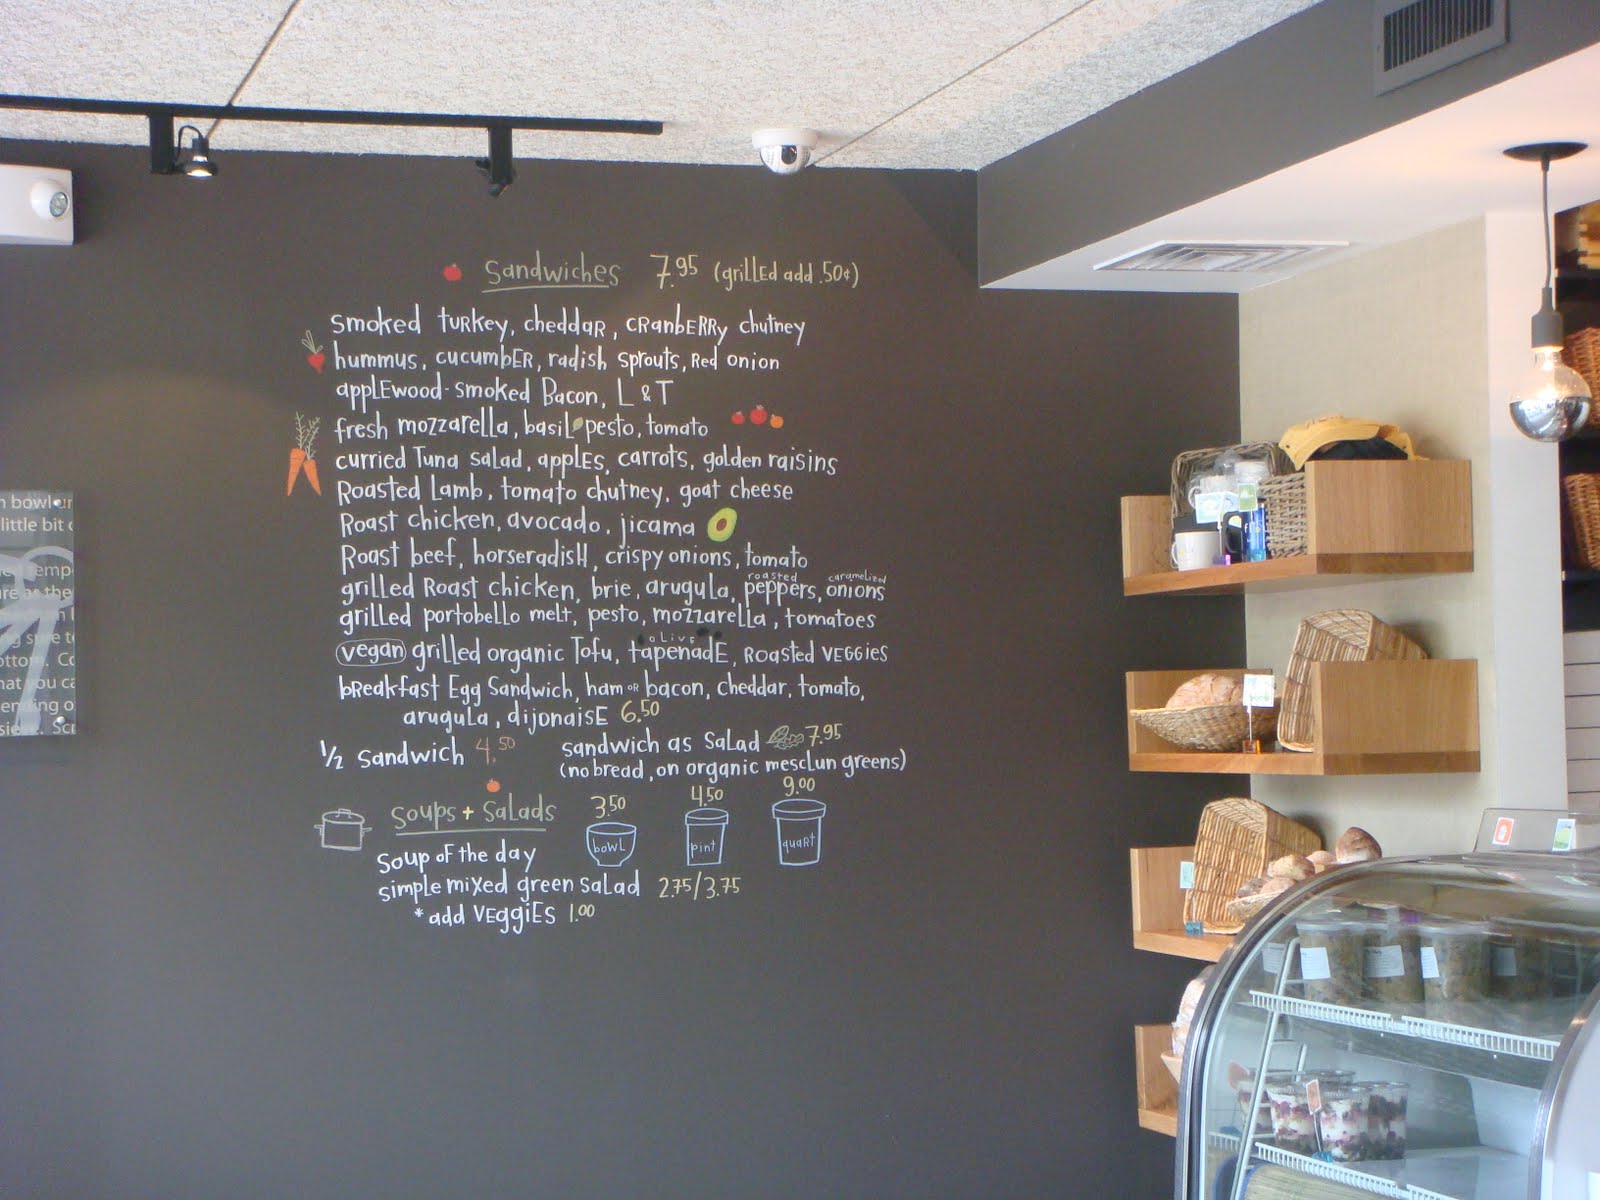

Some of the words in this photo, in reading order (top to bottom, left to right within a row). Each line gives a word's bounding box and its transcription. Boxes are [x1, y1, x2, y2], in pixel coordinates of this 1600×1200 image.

[485, 250, 620, 287] Sandwiches
[650, 254, 698, 289] 7.95
[783, 262, 813, 284] add
[739, 309, 806, 346] chutney
[333, 340, 426, 371] hummus,
[548, 344, 607, 371] radish
[618, 347, 686, 377] sprouts,
[691, 346, 717, 370] Red
[727, 352, 780, 371] onion
[542, 377, 606, 409] Bacon,
[617, 378, 634, 406] L
[641, 385, 651, 402] &
[655, 380, 674, 405] T
[334, 411, 388, 443] fresh
[648, 413, 709, 437] tomato
[335, 443, 406, 470] curried
[413, 446, 459, 469] Tuna
[618, 444, 694, 470] carrots,
[768, 447, 838, 475] raisins
[12, 494, 51, 510] bowl
[337, 475, 421, 506] Roasted
[431, 472, 493, 501] Lamb,
[500, 476, 577, 505] tomato
[586, 475, 670, 508] chutney,
[679, 479, 721, 507] goat
[730, 476, 793, 500] cheese
[1, 516, 38, 532] little
[42, 516, 65, 532] bit
[340, 510, 399, 537] Roast
[407, 505, 501, 531] chicken,
[507, 505, 611, 535] avocado,
[619, 512, 695, 549] jicama
[341, 541, 400, 575] Roast
[410, 537, 463, 569] beef,
[605, 547, 663, 571] crispy
[668, 545, 740, 569] onions,
[744, 542, 808, 568] tomato
[424, 576, 478, 599] Roast
[488, 571, 581, 603] chicken,
[591, 575, 640, 600] brie,
[744, 580, 822, 607] peppers,
[826, 583, 886, 601] onions
[748, 572, 798, 582] roasted
[588, 604, 647, 632] pesto,
[785, 608, 876, 629] tomatoes
[341, 642, 404, 664] vegan
[487, 643, 564, 673] organic
[571, 636, 620, 665] Tofu,
[744, 640, 815, 663] Roasted
[449, 675, 481, 707] Egg
[585, 672, 624, 696] ham
[645, 670, 711, 700] bacon,
[717, 672, 792, 698] cheddar,
[798, 674, 865, 701] tomato,
[0, 698, 59, 716] ening
[620, 700, 660, 723] 6.50
[357, 735, 465, 768] sandwich
[475, 736, 516, 765] 4.50
[561, 727, 660, 757] sandwich
[667, 736, 692, 752] as
[805, 724, 843, 747] 7.95
[656, 765, 680, 777] on
[686, 759, 759, 784] organic
[841, 748, 907, 778] greens)
[691, 785, 724, 807] 4.50
[783, 776, 816, 797] 9.00
[391, 801, 456, 831] Soups
[462, 806, 475, 820] +
[591, 794, 626, 819] 3.50
[377, 845, 430, 874] Soup
[458, 843, 488, 863] the
[495, 838, 536, 872] day
[690, 839, 716, 859] pint
[517, 875, 574, 902] green
[659, 871, 741, 900] 2.75/3.75
[429, 903, 465, 927] add
[570, 903, 595, 923] 1.00
